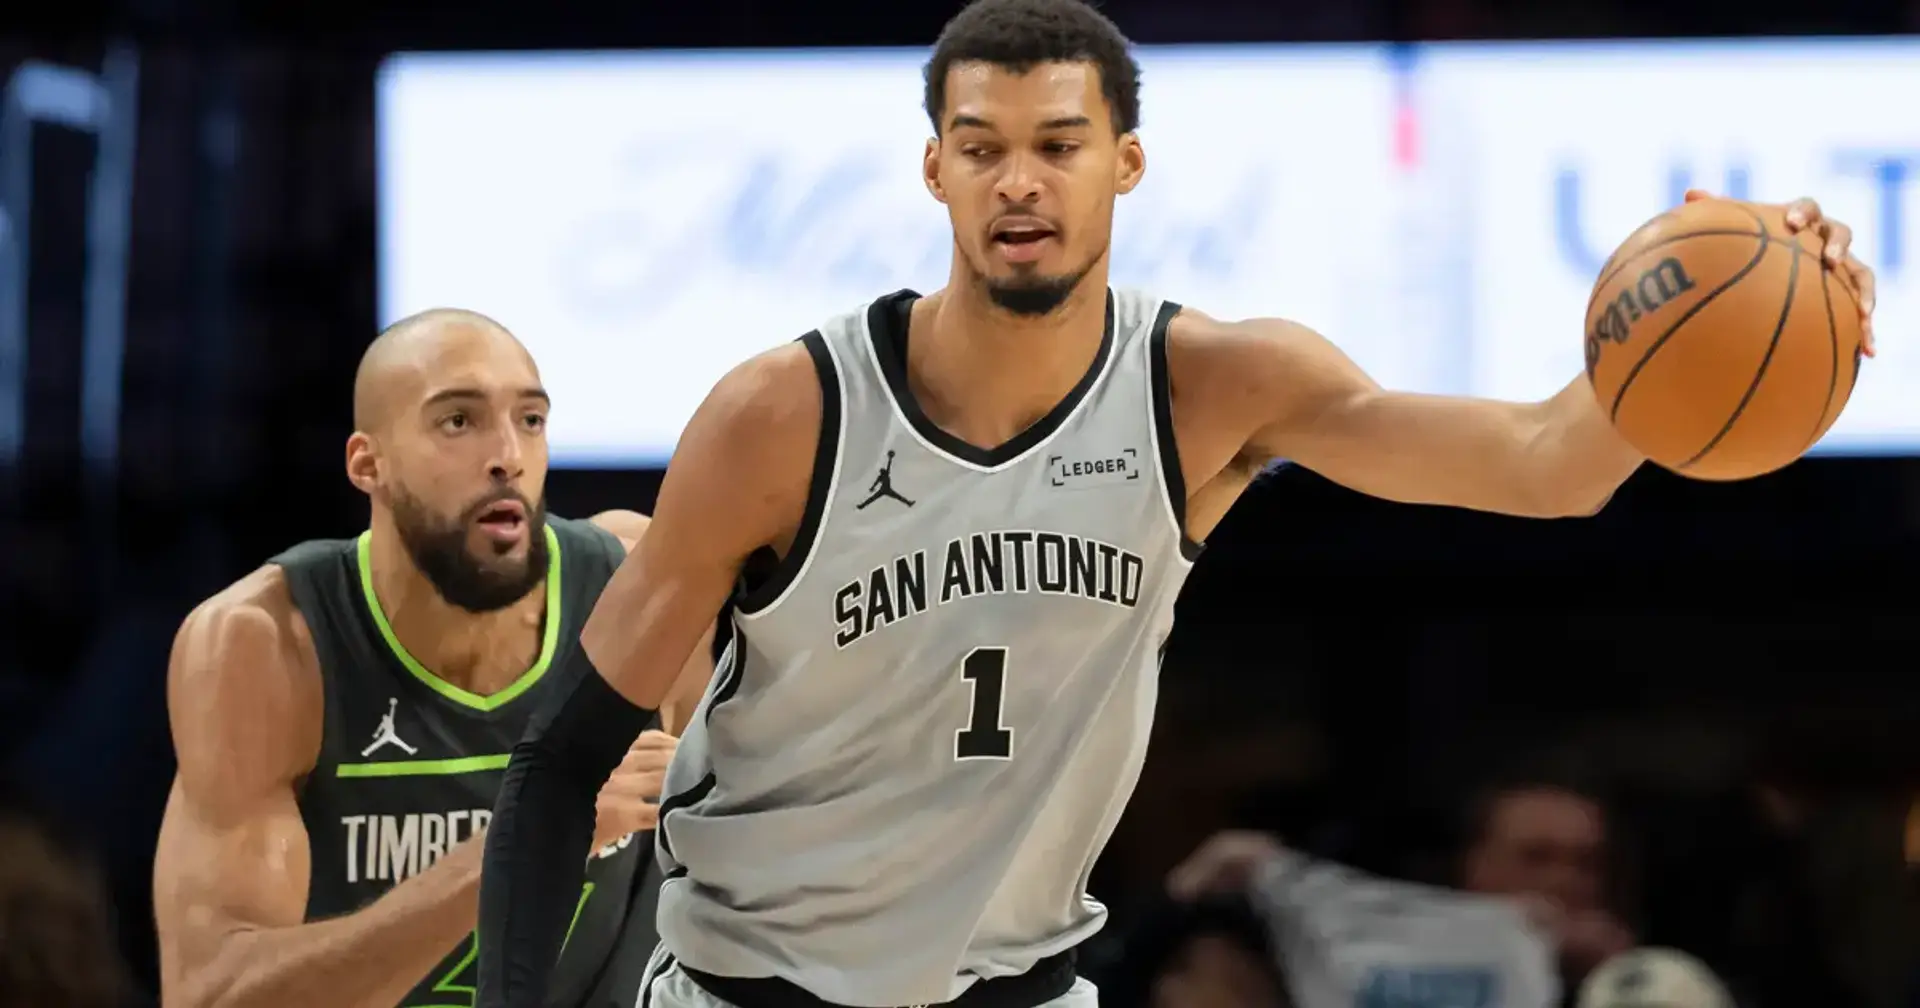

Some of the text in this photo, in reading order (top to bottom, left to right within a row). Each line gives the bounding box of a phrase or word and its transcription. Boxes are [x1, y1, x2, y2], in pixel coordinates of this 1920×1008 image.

[1585, 256, 1696, 380] Wilso
[1062, 458, 1126, 477] LEDGER
[835, 530, 1144, 649] SAN ANTONIO
[954, 646, 1014, 761] 1
